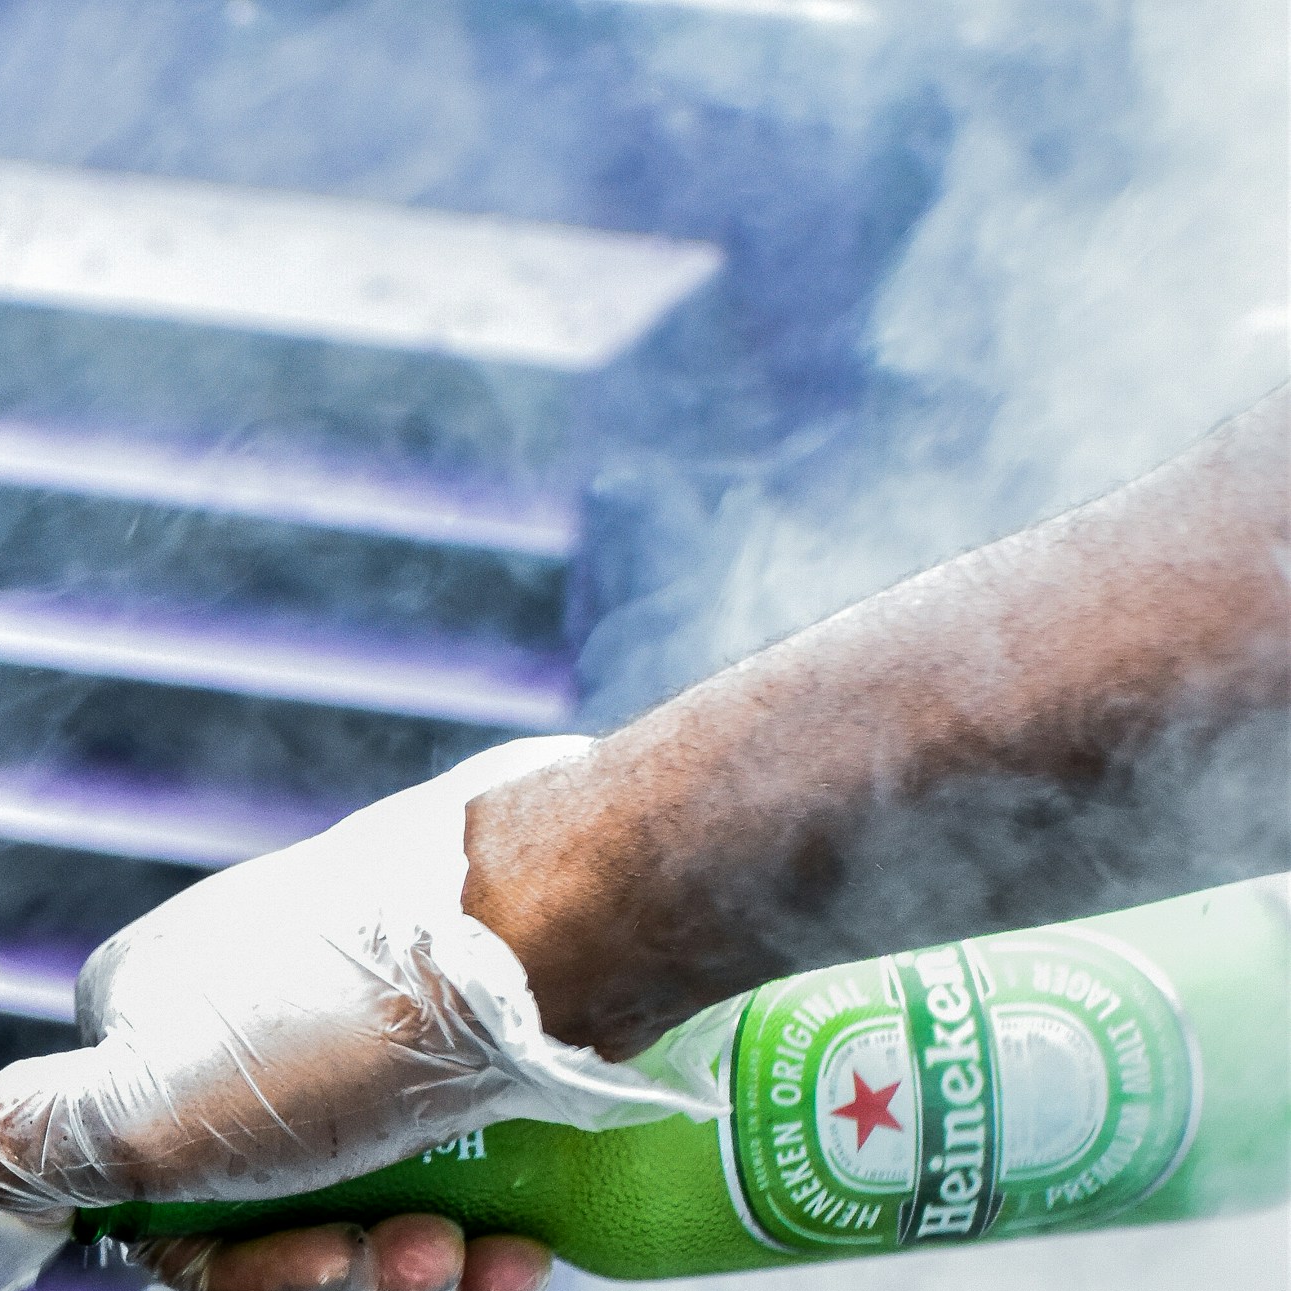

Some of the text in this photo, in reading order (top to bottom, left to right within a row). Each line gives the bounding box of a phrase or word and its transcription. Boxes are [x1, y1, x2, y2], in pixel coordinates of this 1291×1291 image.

[772, 977, 868, 1106] ORIGINAL
[1032, 961, 1121, 1021] LAGER
[915, 947, 985, 1238] Heineken
[1107, 1020, 1151, 1095] MALT
[772, 1118, 882, 1230] HEINEKEN
